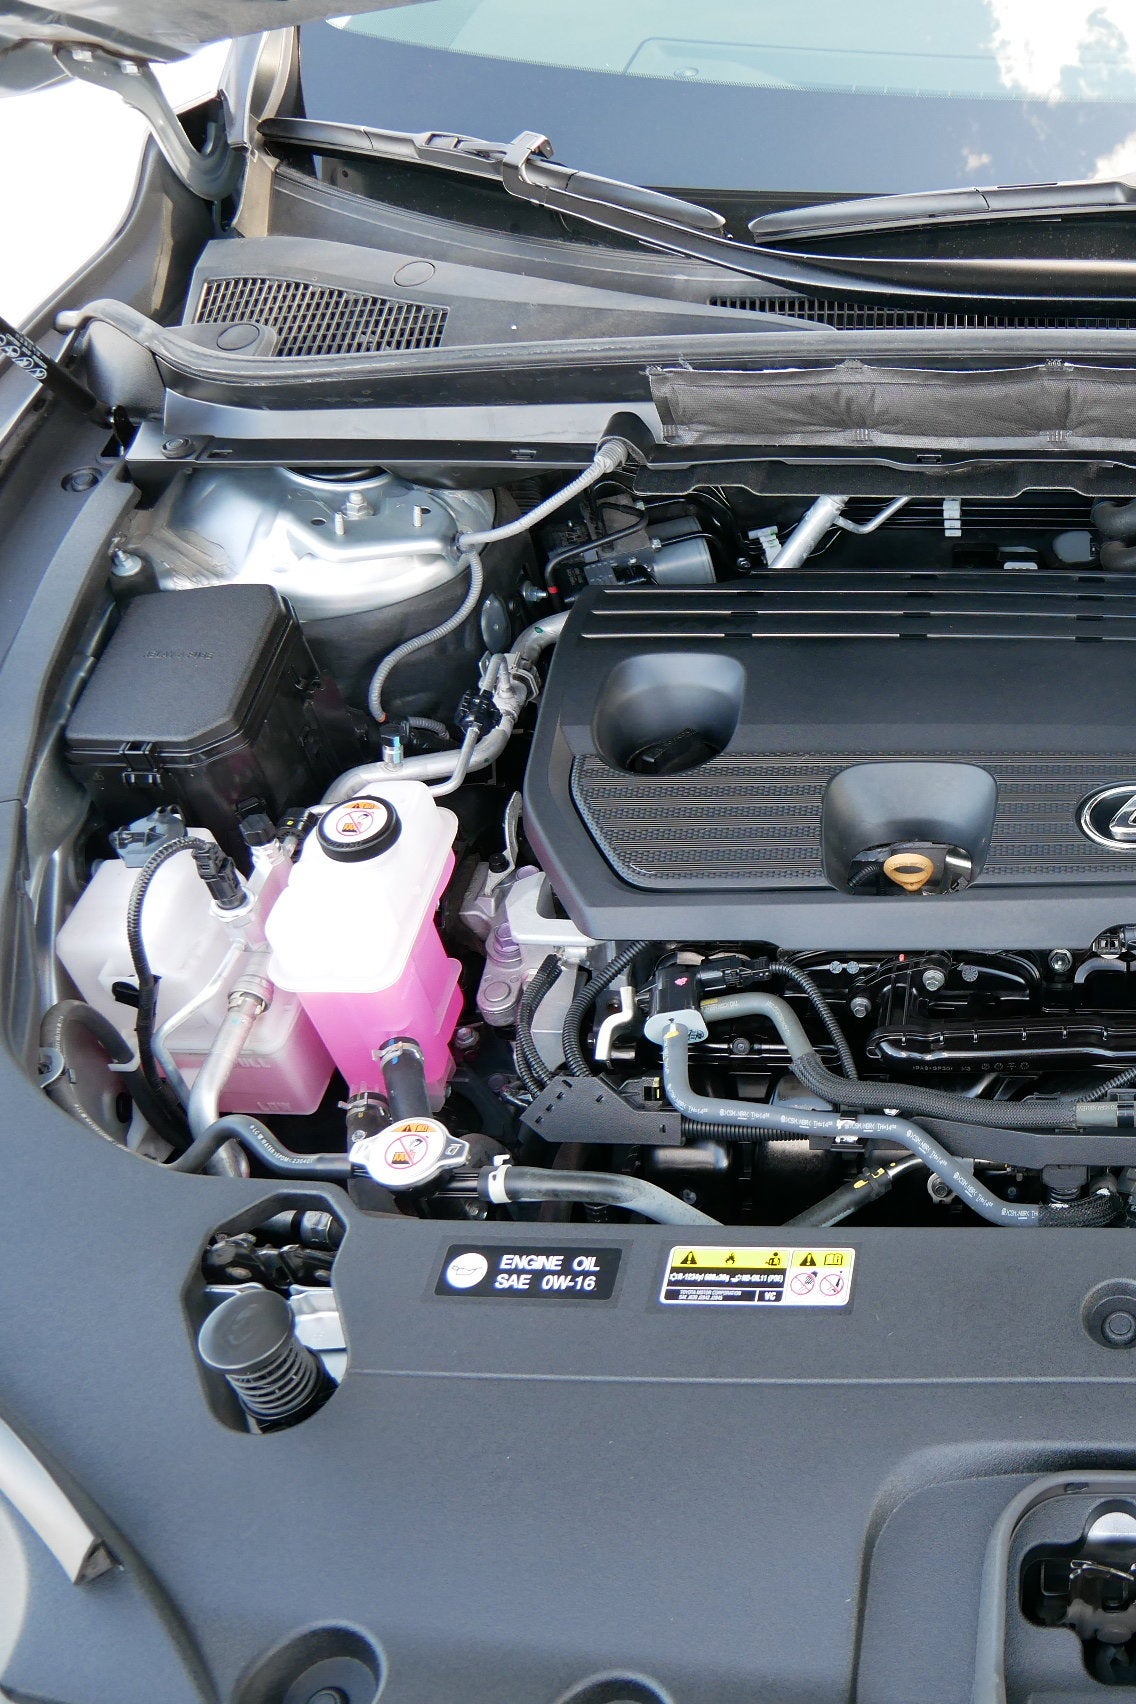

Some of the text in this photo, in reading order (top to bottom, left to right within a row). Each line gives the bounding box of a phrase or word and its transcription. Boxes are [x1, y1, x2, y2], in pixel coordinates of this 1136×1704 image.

[499, 1254, 601, 1272] ENGINE OIL
[494, 1273, 597, 1291] SAE 0W-16
